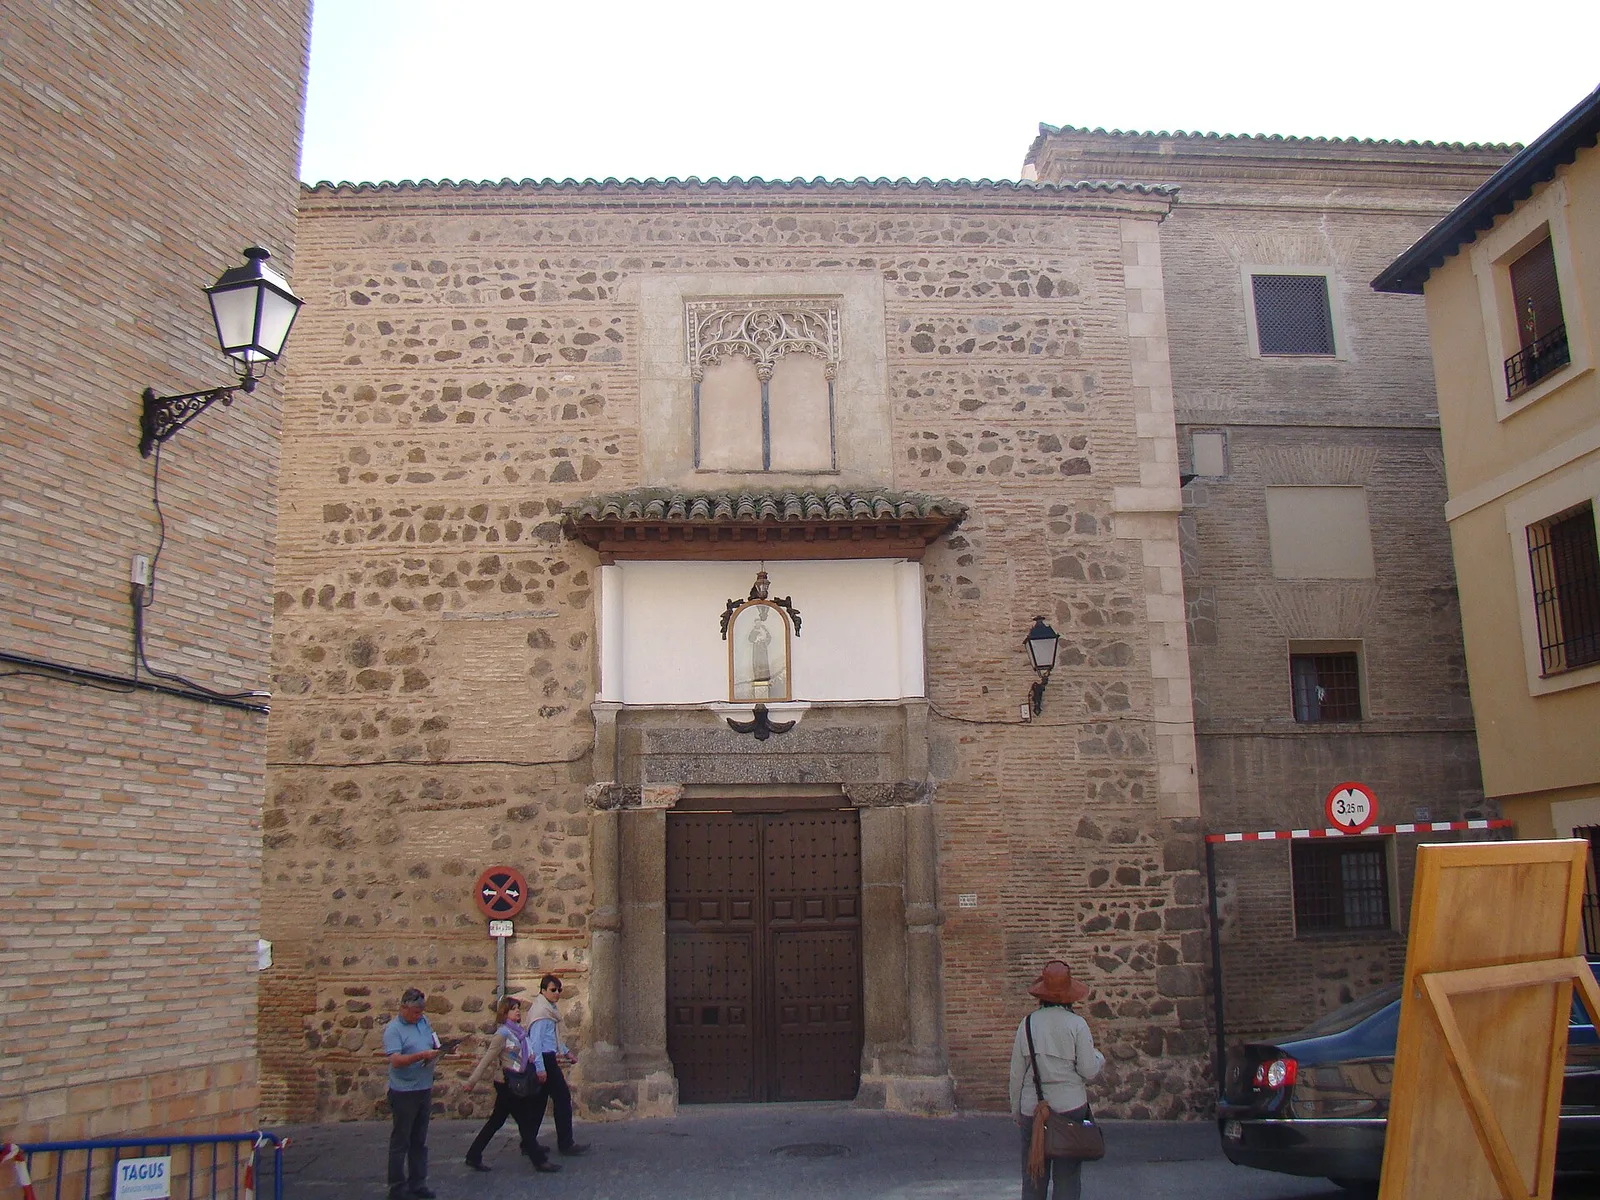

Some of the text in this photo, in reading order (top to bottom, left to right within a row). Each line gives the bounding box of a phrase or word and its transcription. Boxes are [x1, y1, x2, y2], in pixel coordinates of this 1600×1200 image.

[1336, 799, 1364, 815] 3,25 m
[122, 1162, 164, 1181] TAGUS
